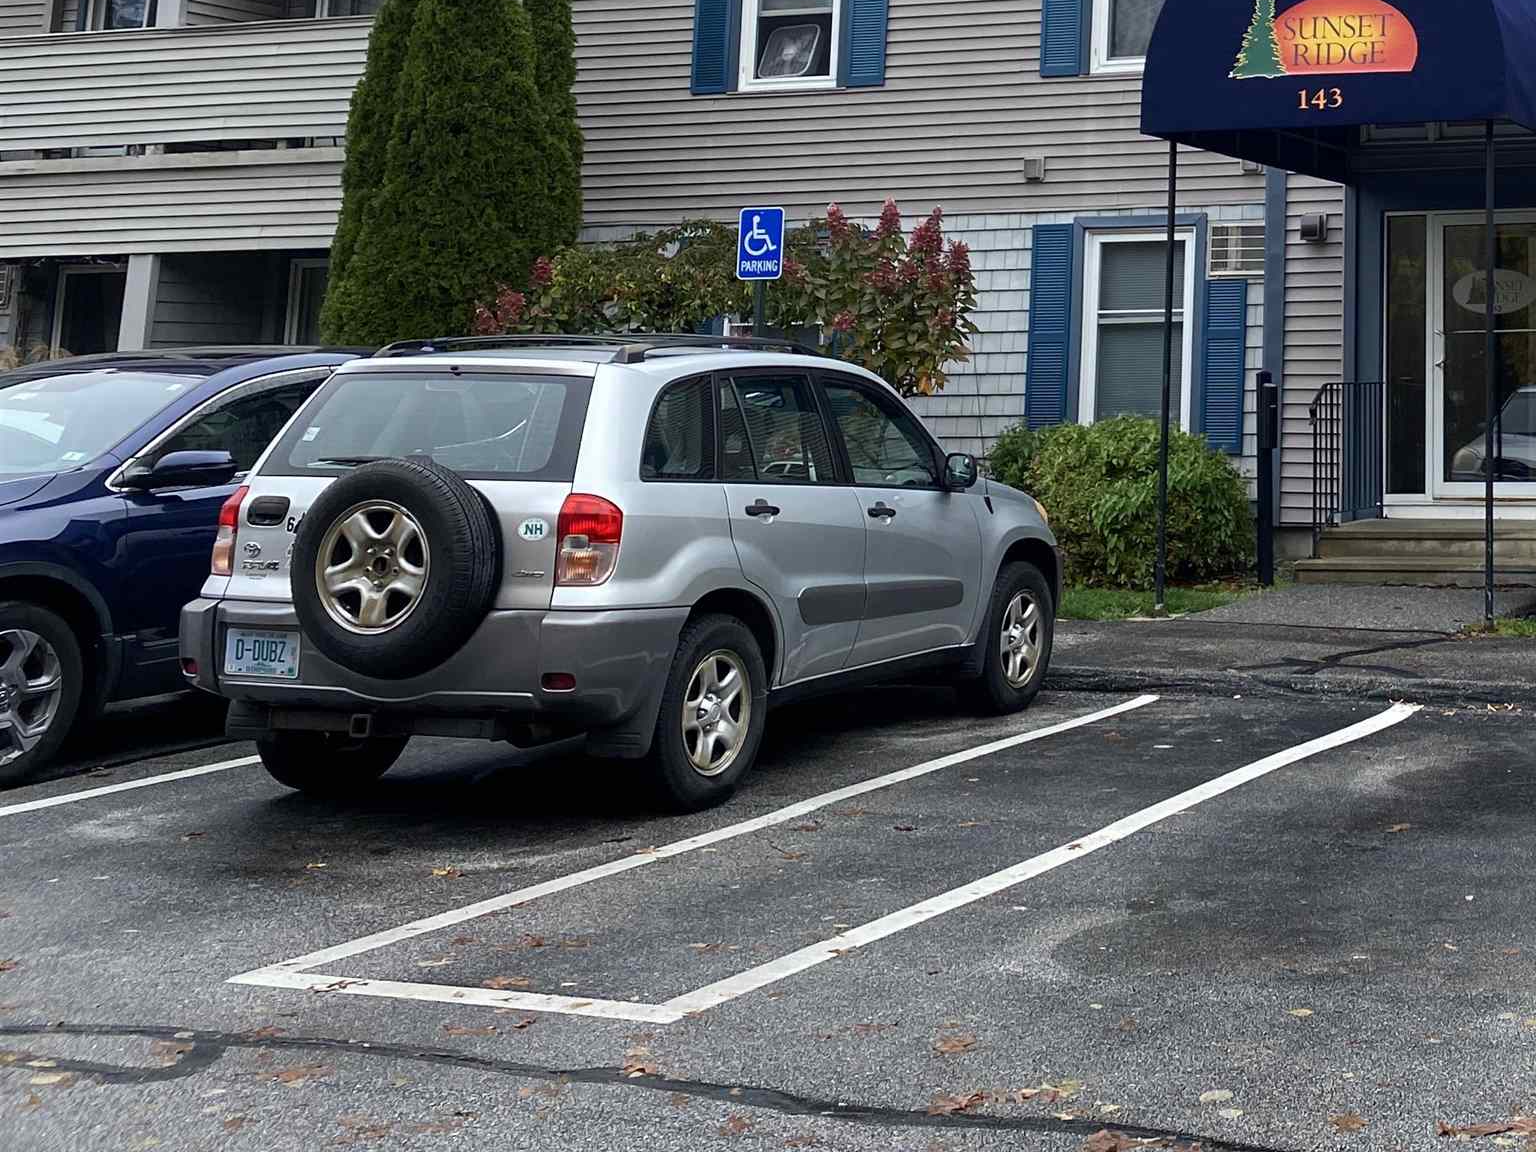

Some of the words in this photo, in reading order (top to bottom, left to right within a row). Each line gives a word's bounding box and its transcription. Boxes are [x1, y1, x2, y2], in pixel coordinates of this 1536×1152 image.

[1283, 13, 1393, 40] SUNSET
[1293, 40, 1386, 66] RIDGE
[1298, 87, 1343, 109] 143
[741, 259, 779, 273] PARKING
[523, 523, 544, 536] NH
